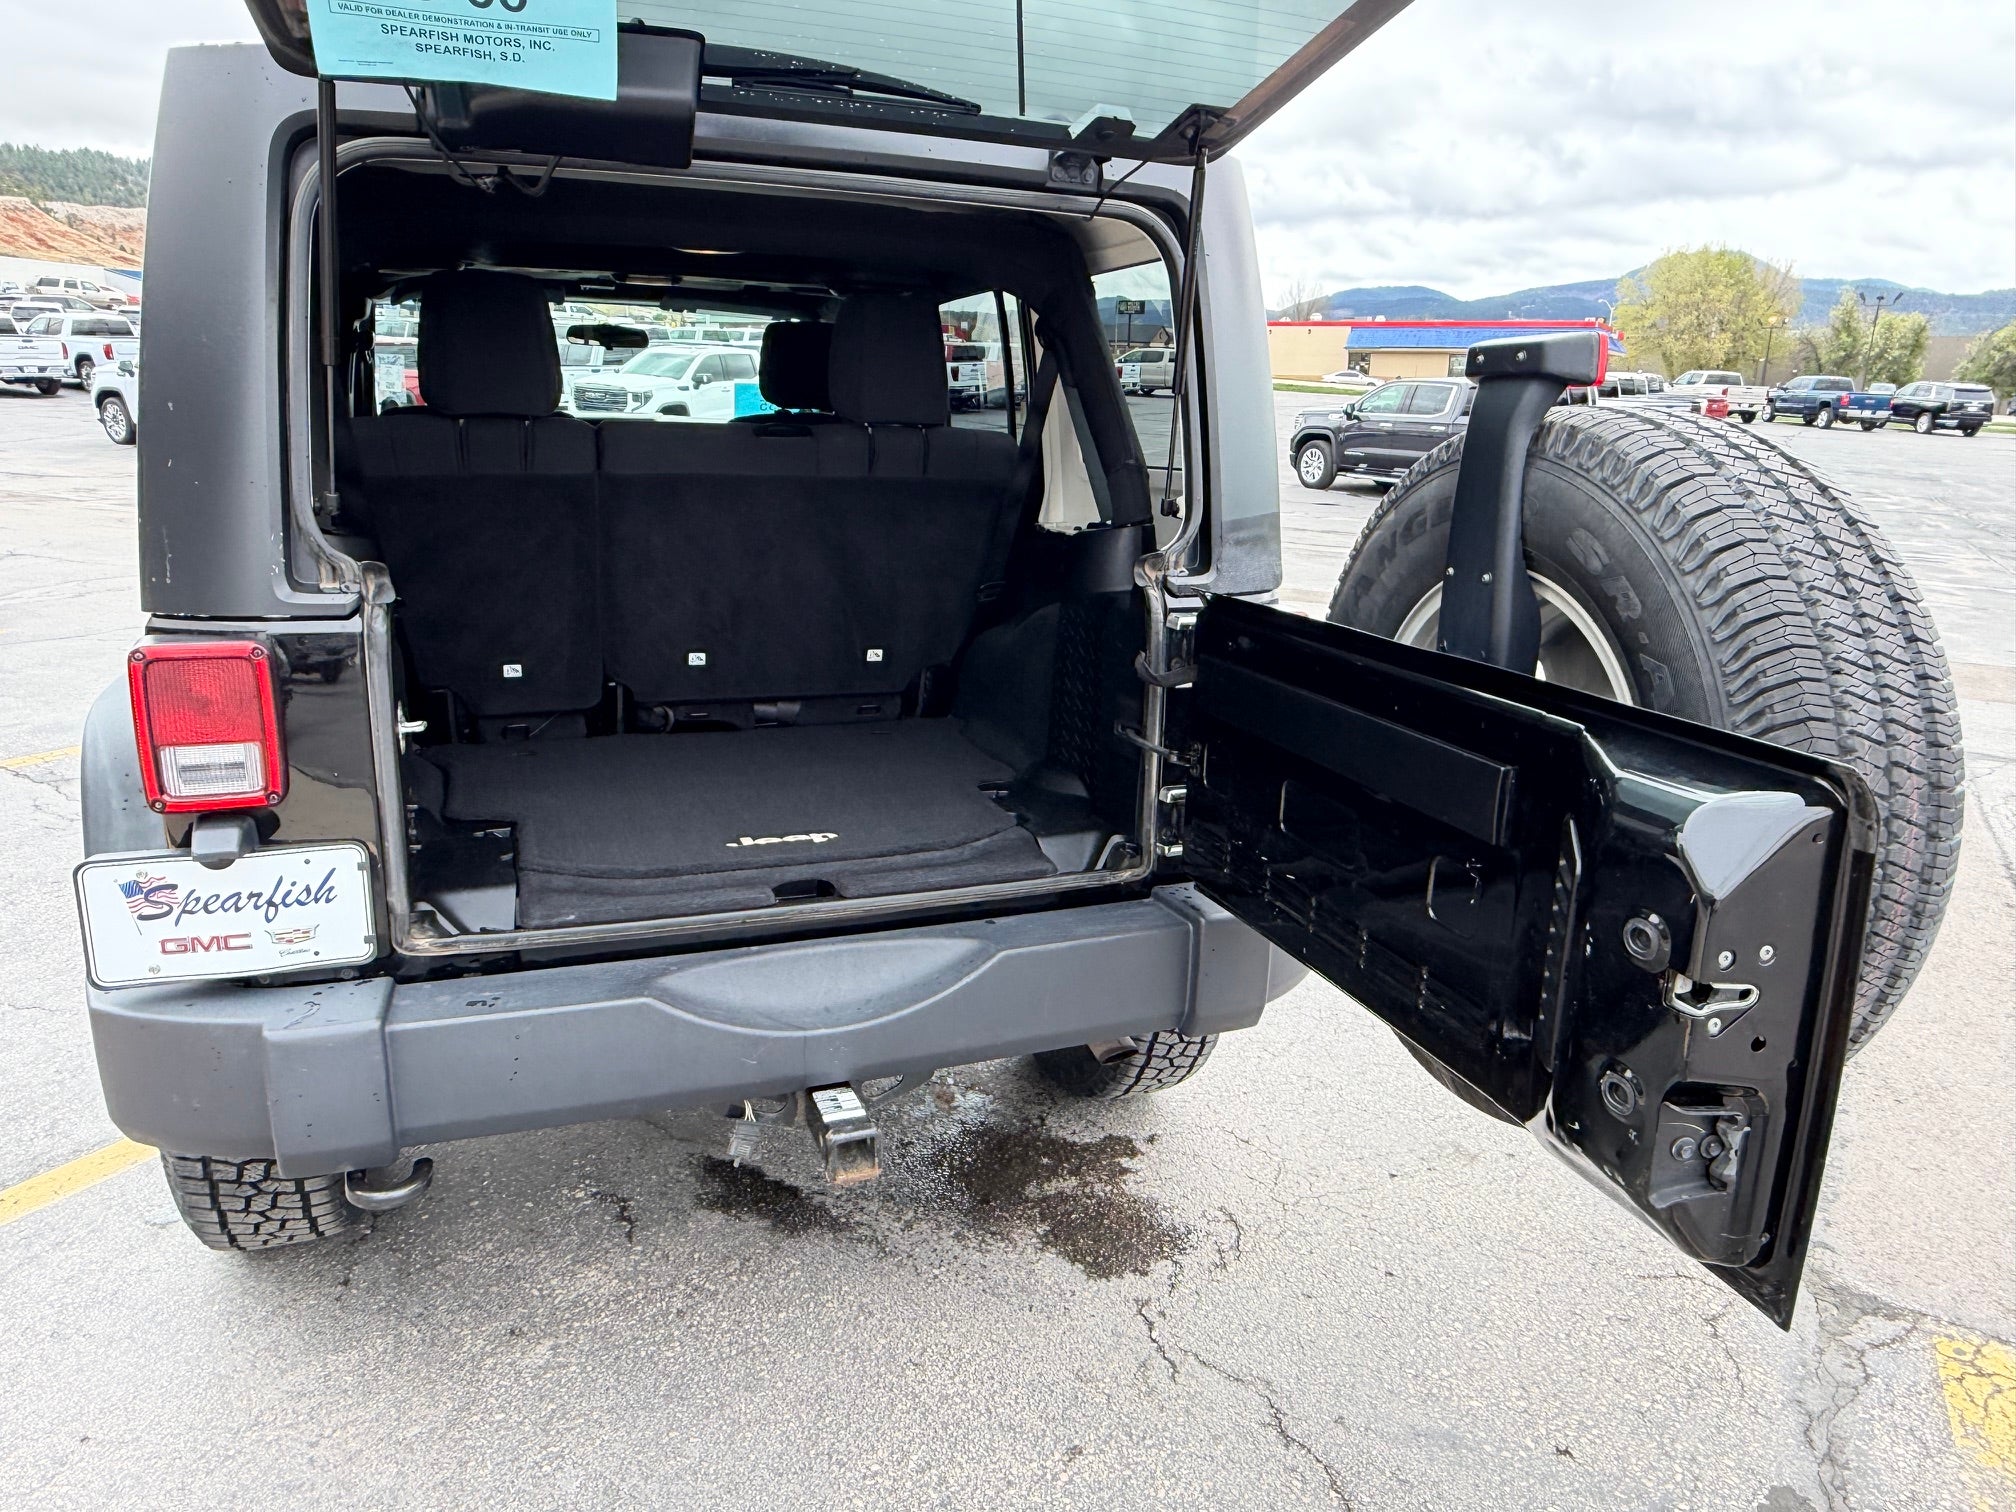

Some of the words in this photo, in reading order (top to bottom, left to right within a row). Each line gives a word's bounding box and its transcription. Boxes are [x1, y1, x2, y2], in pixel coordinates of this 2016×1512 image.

[338, 2, 363, 13] VALID
[365, 6, 383, 15] FOR
[385, 9, 420, 21] DEALER
[422, 14, 494, 29] DEMONSTRATION
[504, 24, 550, 35] IN-TRANSIT
[552, 28, 569, 37] USE
[570, 29, 592, 39] ONLY
[380, 23, 459, 42] SPEARFISH
[463, 33, 526, 51] MOTORS,
[529, 39, 555, 52] INC.
[415, 42, 496, 61] SPEARFISH,
[500, 51, 526, 63] S.D.
[725, 832, 839, 847] Jeep
[136, 867, 338, 927] Spearfish
[159, 931, 254, 956] GMC
